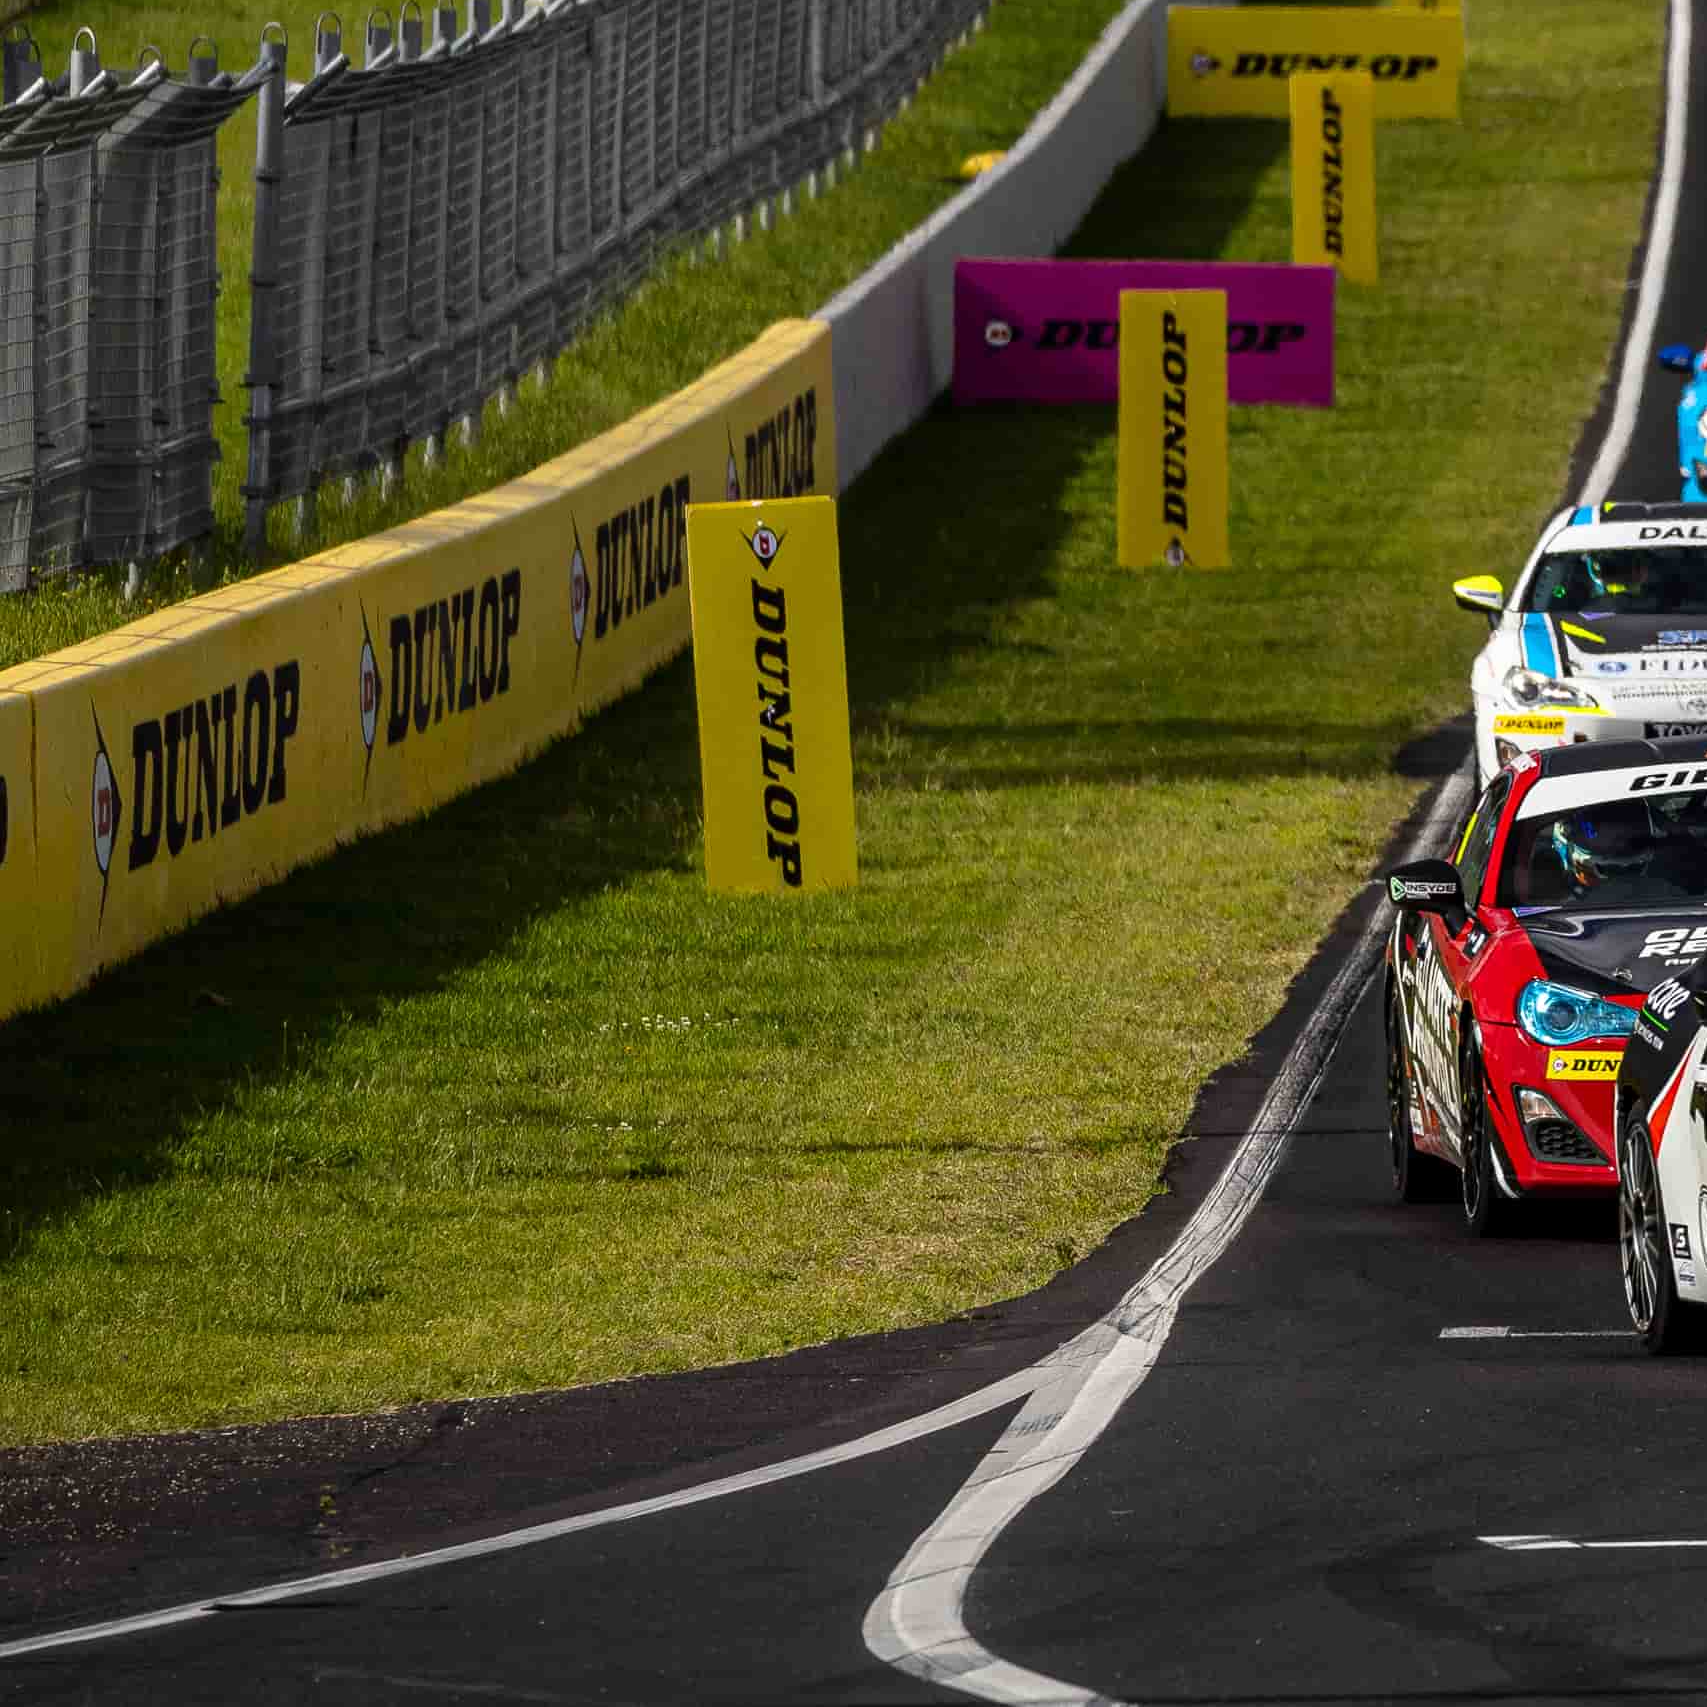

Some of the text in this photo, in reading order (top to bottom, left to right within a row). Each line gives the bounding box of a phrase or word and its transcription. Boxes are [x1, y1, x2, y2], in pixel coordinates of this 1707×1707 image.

[1033, 319, 1306, 353] DUOP
[1162, 310, 1194, 534] DUNLOP
[388, 568, 521, 746] DUNLOP
[751, 576, 802, 890] DUNLOP
[128, 659, 301, 872] DUNLOP
[1569, 1054, 1619, 1074] DUN
